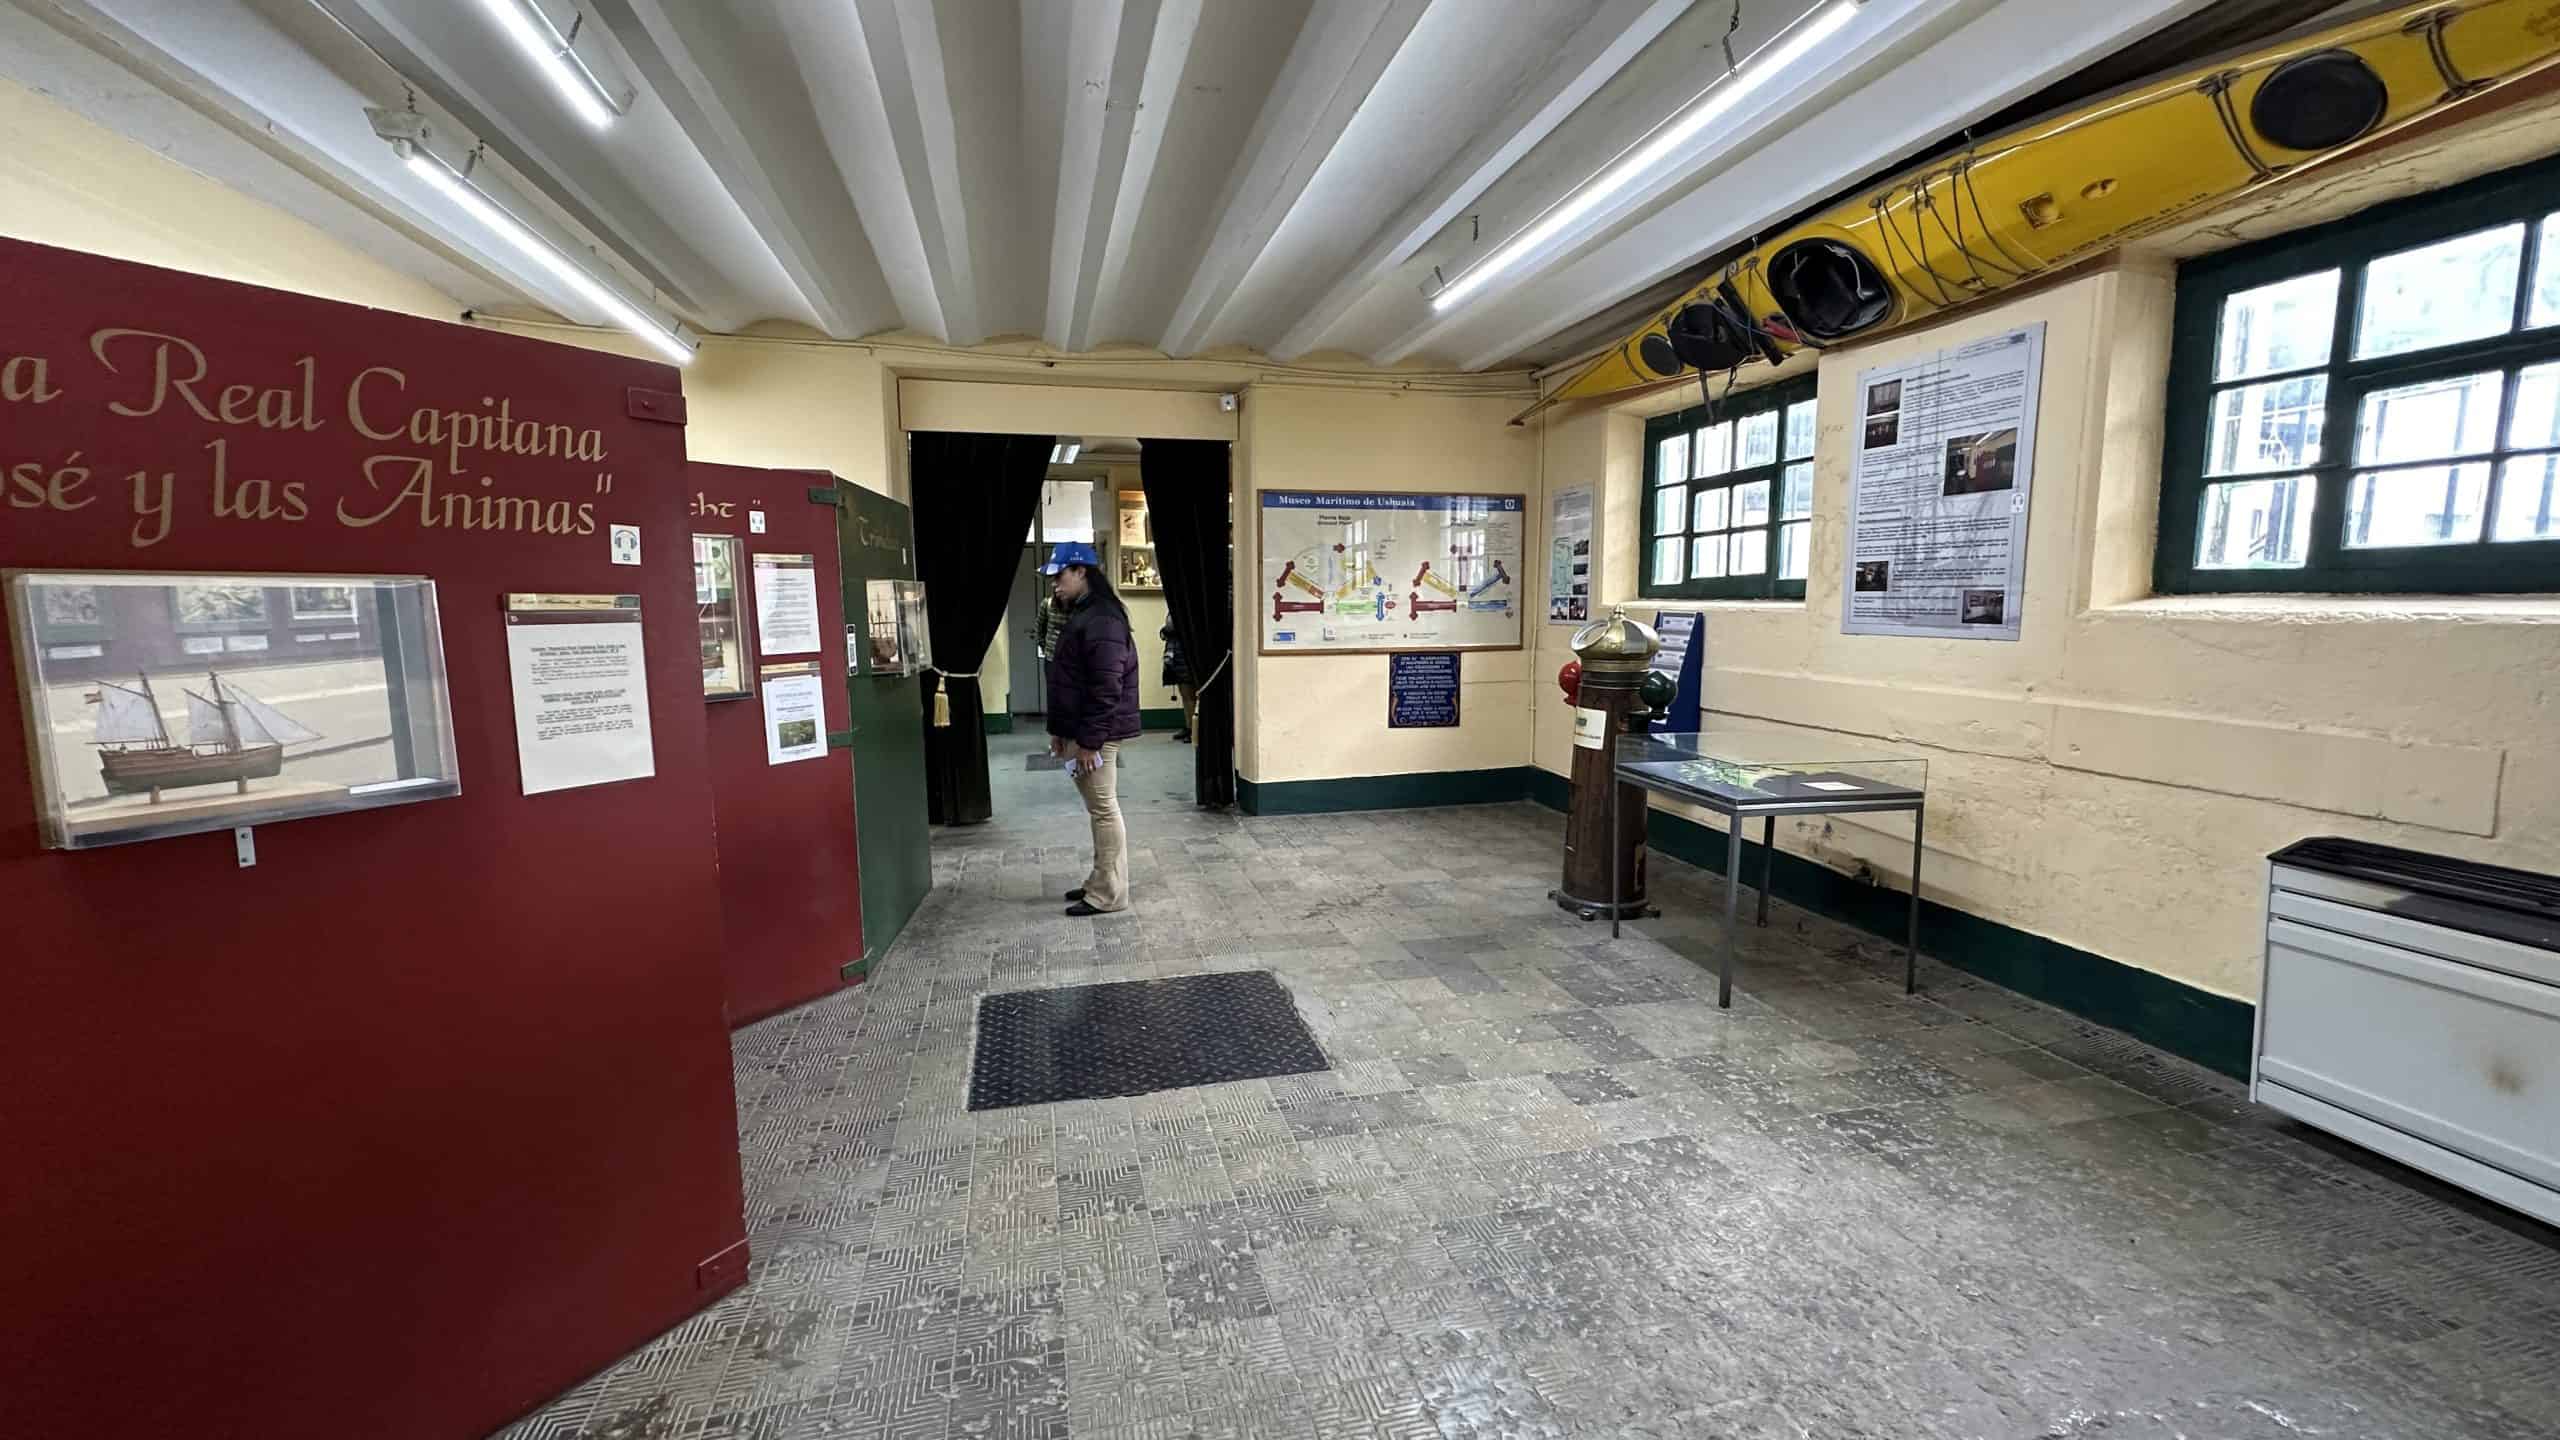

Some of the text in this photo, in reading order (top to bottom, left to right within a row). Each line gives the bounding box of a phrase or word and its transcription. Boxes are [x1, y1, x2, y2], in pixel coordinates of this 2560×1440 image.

[90, 328, 324, 431] Real
[347, 367, 608, 474] Capitana
[0, 451, 97, 511] sé
[124, 471, 175, 547] y
[204, 439, 308, 520] las
[1279, 495, 1311, 505] Museo
[1363, 496, 1375, 506] de
[1377, 496, 1416, 507] Ushuaia
